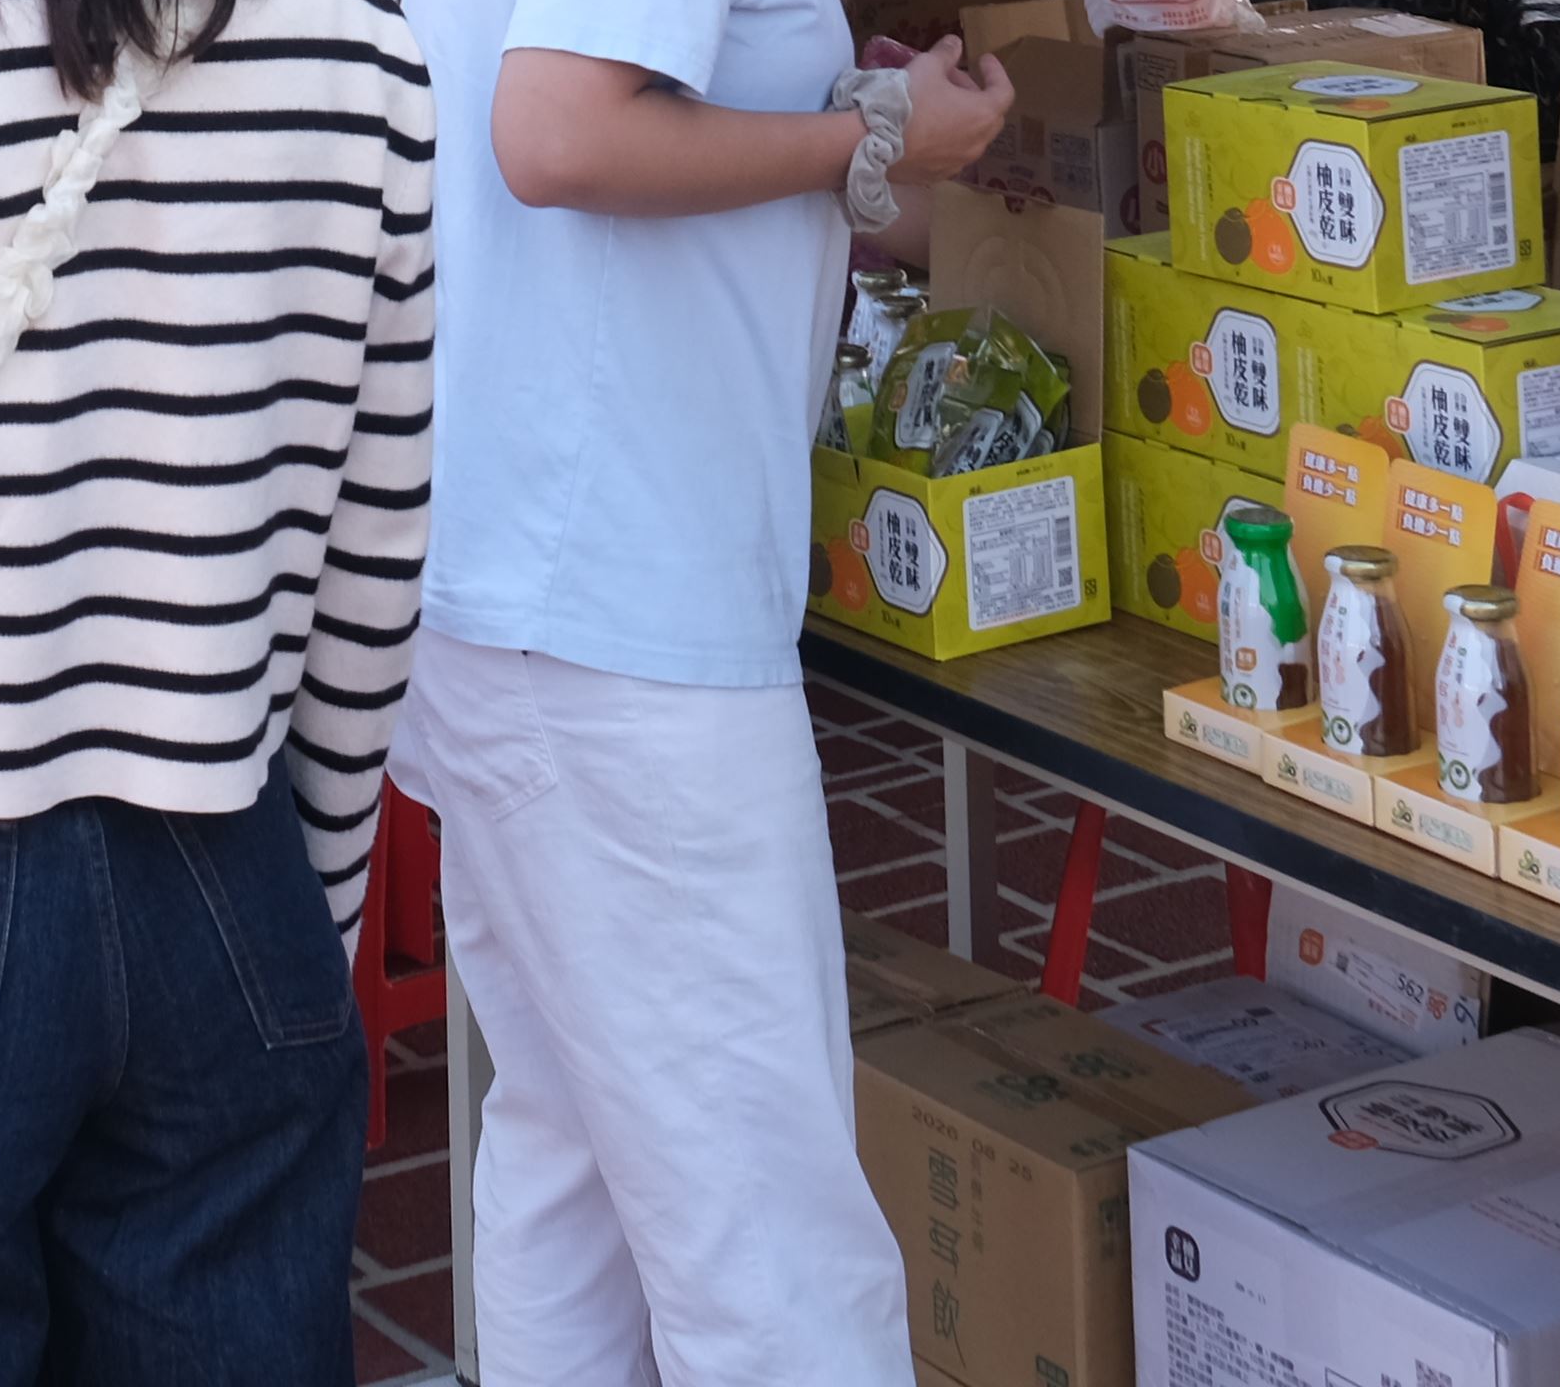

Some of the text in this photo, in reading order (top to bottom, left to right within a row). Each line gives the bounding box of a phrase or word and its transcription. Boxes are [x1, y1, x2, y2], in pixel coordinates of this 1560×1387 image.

[1316, 161, 1337, 242] 柚皮乾
[1338, 191, 1357, 246] 雙味
[1431, 384, 1452, 468] 柚皮乾
[1453, 416, 1473, 474] 雙味
